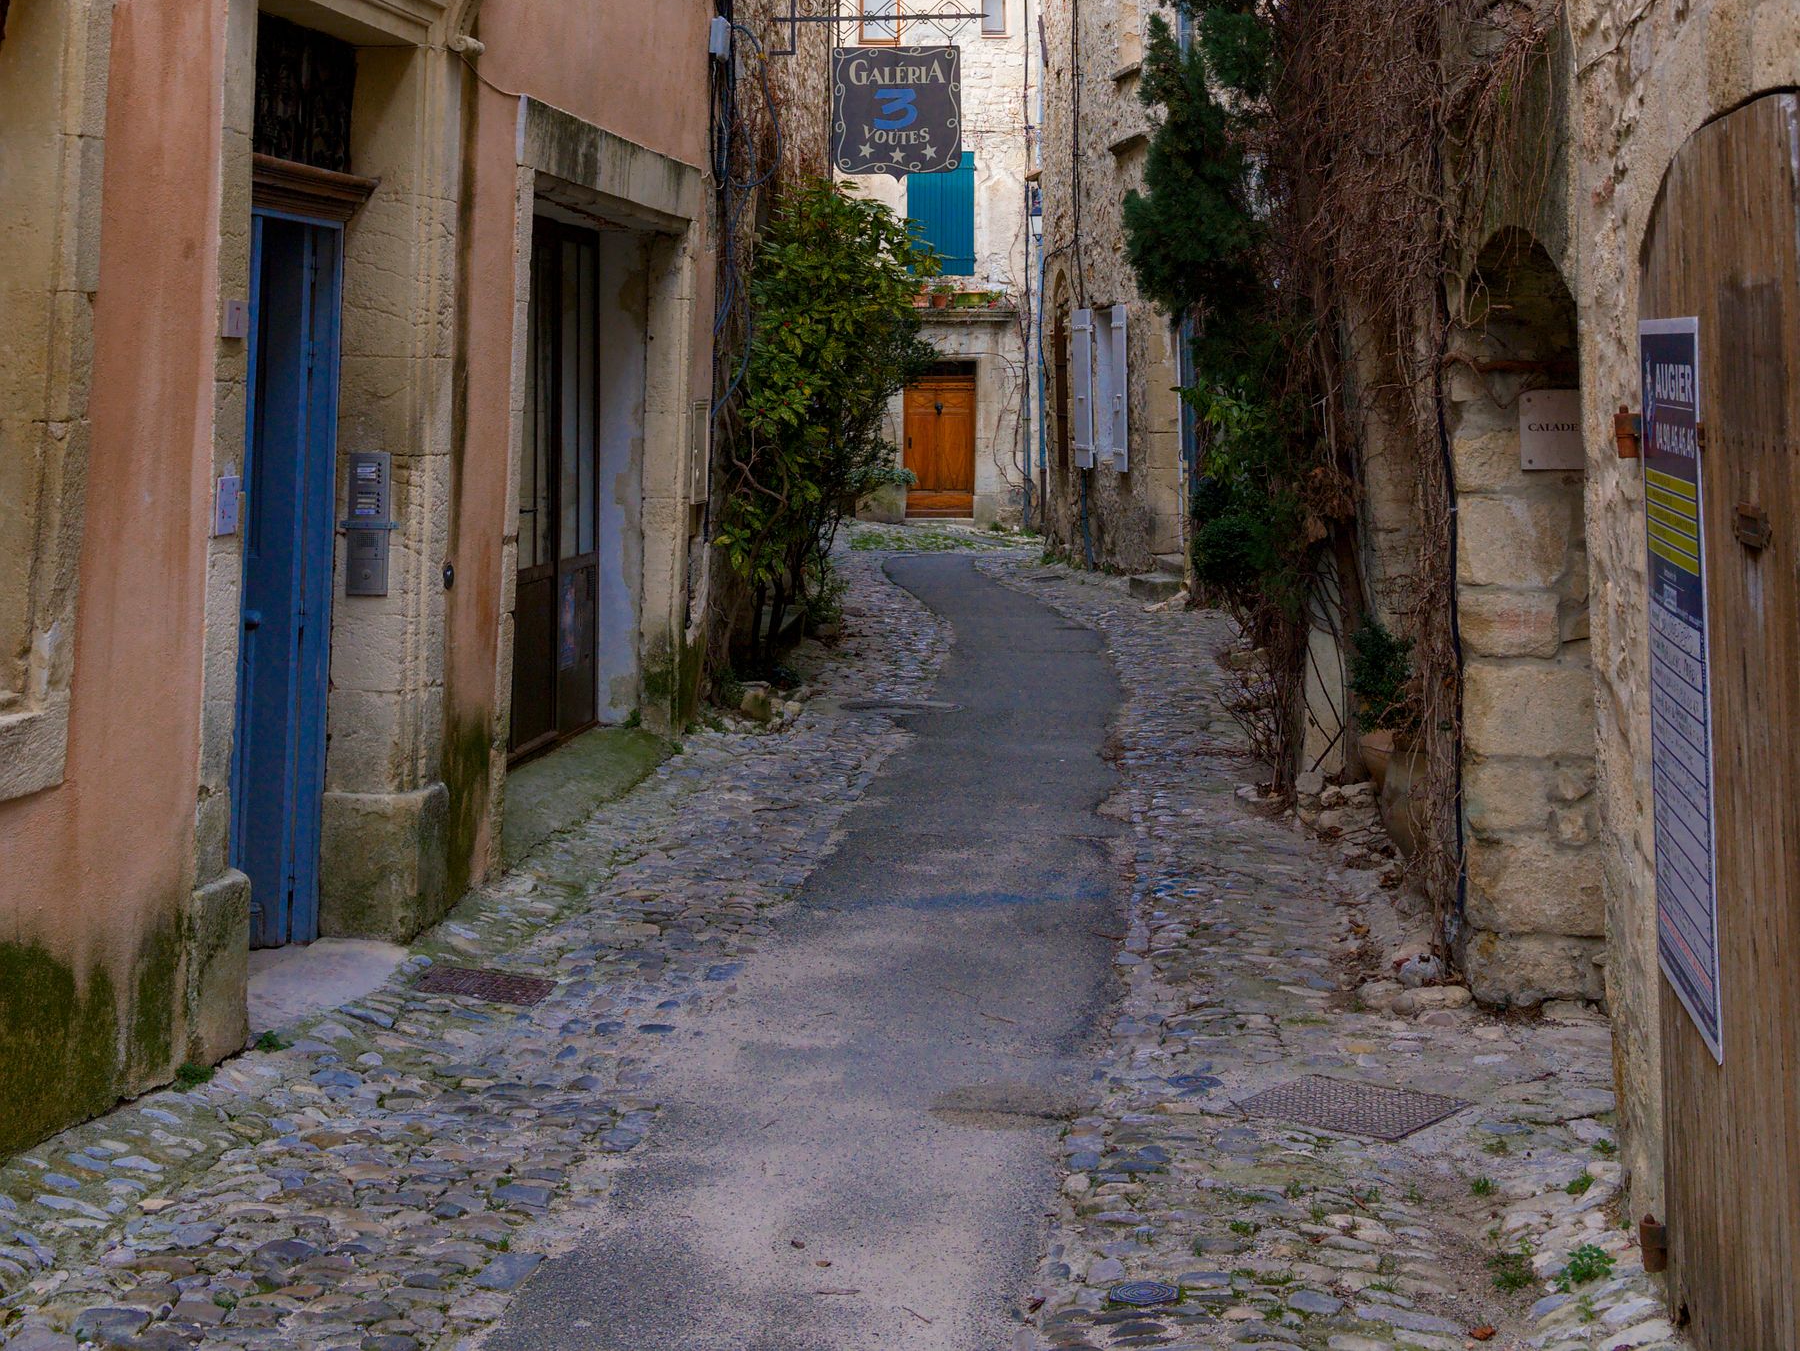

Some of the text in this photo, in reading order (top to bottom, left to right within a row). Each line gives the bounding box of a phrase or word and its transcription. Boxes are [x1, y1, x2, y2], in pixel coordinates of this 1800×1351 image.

[850, 60, 945, 85] GALÉRIA
[874, 89, 918, 129] 3
[1655, 363, 1693, 403] AUGIER
